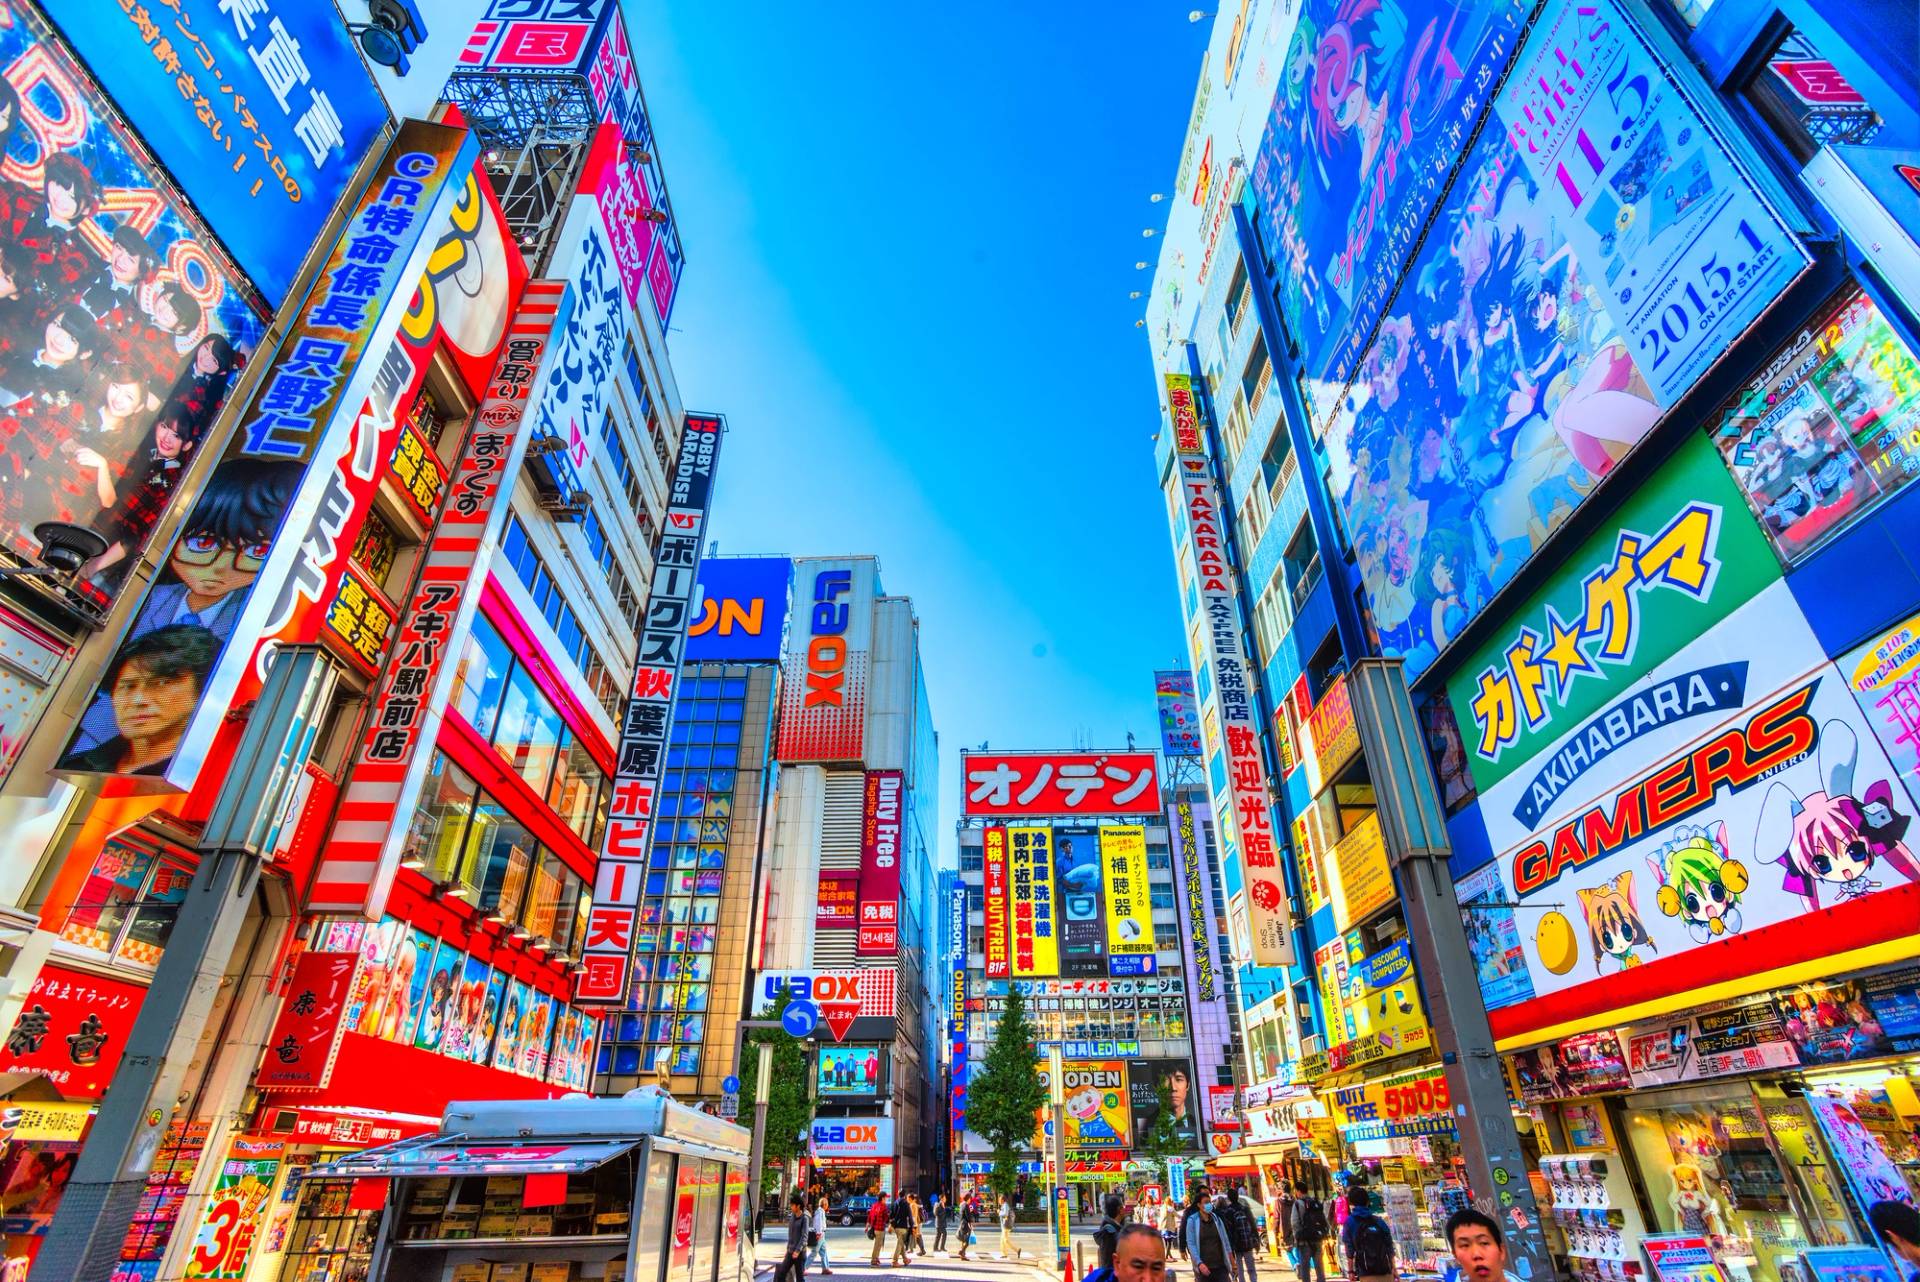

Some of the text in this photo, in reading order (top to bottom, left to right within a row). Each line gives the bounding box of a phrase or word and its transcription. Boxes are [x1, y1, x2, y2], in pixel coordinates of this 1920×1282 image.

[1552, 53, 1650, 218] 11.5
[1624, 94, 1663, 150] ON SALE
[242, 152, 438, 458] CR特命係長 只野仁
[1640, 218, 1771, 372] 2015.1
[1640, 276, 1680, 325] ANIMATION
[1699, 245, 1776, 331] ON AIR START
[498, 339, 541, 400] 買取り
[457, 433, 505, 516] まっくす
[671, 418, 705, 505] PARADISE
[693, 418, 719, 478] HOBBY
[1187, 483, 1227, 592] TAKARADA
[369, 586, 456, 759] アキバ駅前店
[1216, 657, 1249, 721] 免税商店
[1530, 675, 1717, 815] AKIHABARA
[1756, 749, 1809, 783] ANIBRO
[967, 756, 1153, 807] オノデン
[1513, 687, 1821, 897] GAMERS
[866, 777, 879, 847] Flagship Store
[876, 777, 900, 868] Duty Free
[1103, 829, 1142, 837] Panasonic
[987, 831, 1003, 862] 免税
[1110, 856, 1132, 917] 補聴器
[1132, 855, 1145, 908] パナソニックの
[862, 931, 894, 944] 면세점
[863, 905, 894, 920] 免税
[953, 888, 965, 1033] Panasonic ONODEN
[988, 961, 1007, 974] B1F
[1371, 946, 1402, 969] DISCOUNT
[1371, 956, 1408, 982] COMPUTERS
[308, 957, 351, 1043] ラーメン
[828, 1008, 854, 1021] 止まれ
[1090, 1044, 1114, 1057] LED
[1356, 1045, 1384, 1063] MOBILES
[1039, 1071, 1121, 1088] OODEN
[1336, 1086, 1366, 1107] DUTY
[1346, 1102, 1379, 1123] FREE
[213, 1185, 249, 1202] ポイント
